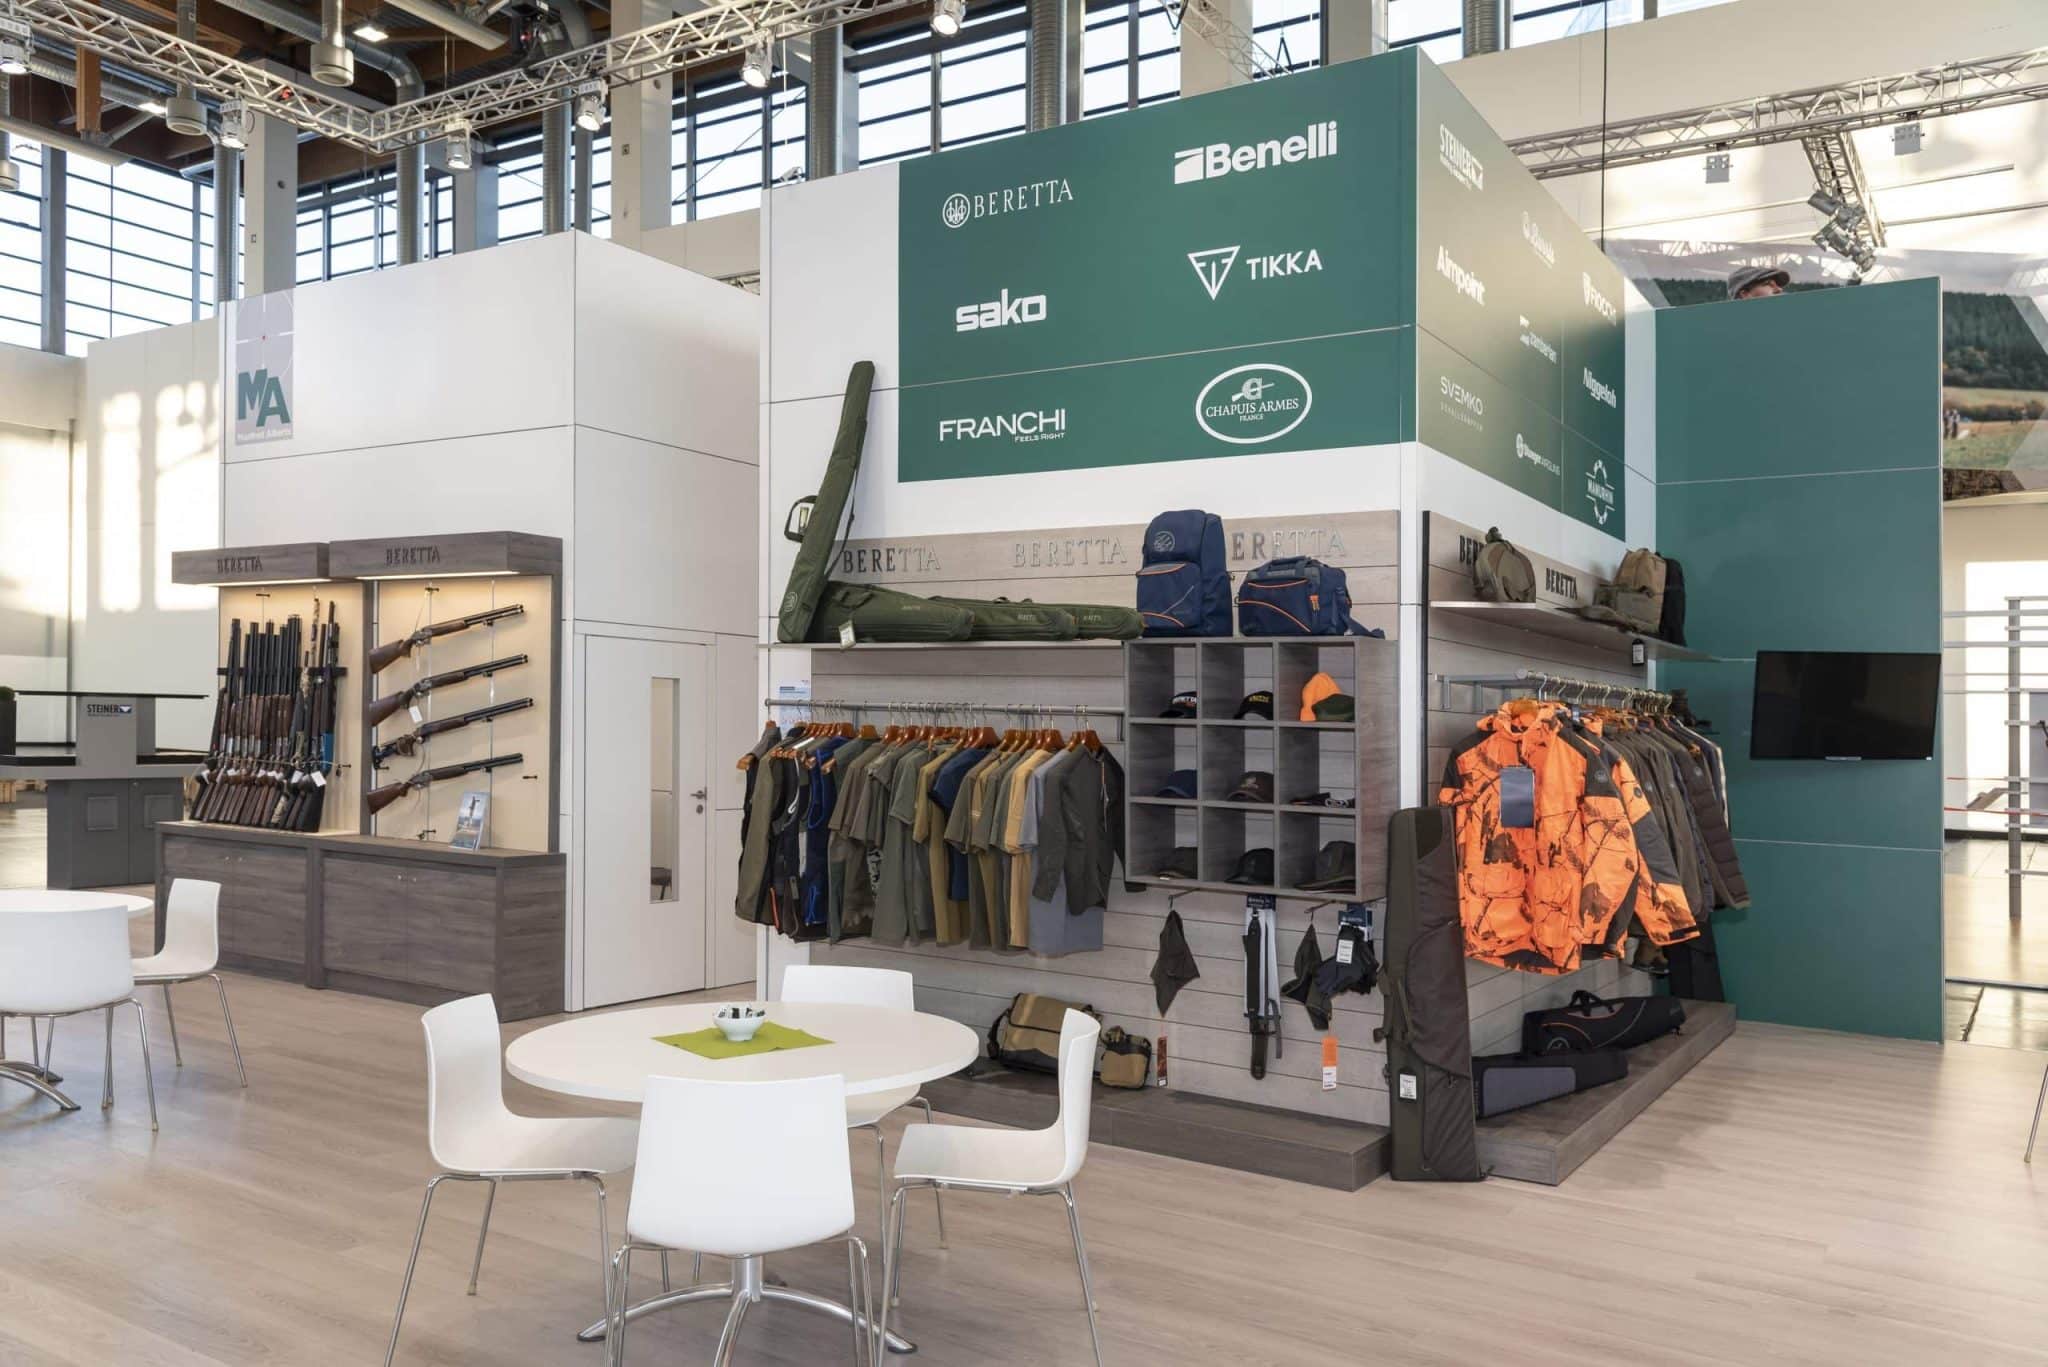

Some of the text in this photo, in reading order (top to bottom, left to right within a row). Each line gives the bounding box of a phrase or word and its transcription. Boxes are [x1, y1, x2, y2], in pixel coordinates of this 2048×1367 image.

[1205, 121, 1337, 179] Benelli
[974, 179, 1073, 218] BERETTA
[1247, 249, 1323, 280] TIKKA
[1436, 245, 1485, 305] Aimpoint
[956, 288, 1047, 332] sako
[1440, 376, 1483, 415] SVEMKO
[1583, 367, 1616, 408] Niggeloh
[1206, 398, 1299, 417] CHAPUIS ARMES
[1240, 413, 1264, 422] FRANCE
[940, 408, 1065, 441] FRANCHI
[1014, 432, 1065, 442] FEELS RIGHT
[386, 546, 440, 567] BERETTA
[842, 543, 941, 574] BERETTA
[1013, 537, 1127, 567] BERETTA
[1231, 528, 1347, 560] ERETTA
[217, 556, 262, 574] BERETTA
[1545, 567, 1578, 600] BERETTA
